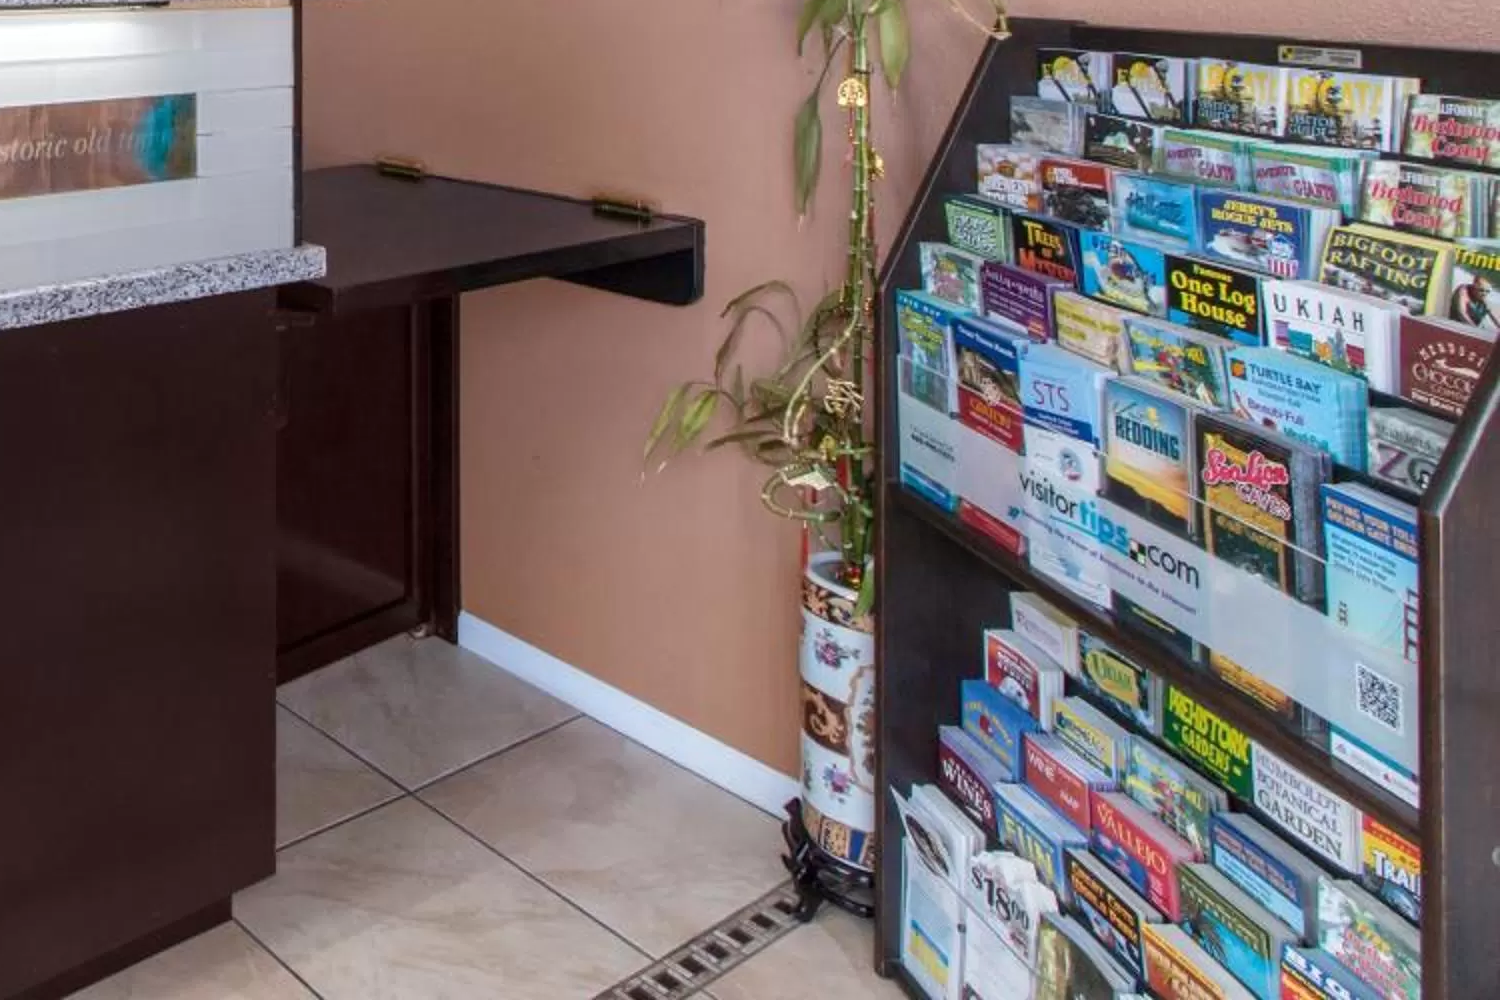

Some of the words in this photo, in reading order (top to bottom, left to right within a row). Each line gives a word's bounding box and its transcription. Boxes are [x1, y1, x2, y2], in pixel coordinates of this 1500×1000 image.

[73, 127, 112, 155] old
[1328, 250, 1429, 290] RAFTING
[1332, 234, 1434, 272] BIGFOOT
[1171, 269, 1214, 297] One
[1219, 281, 1256, 315] Log
[1180, 290, 1247, 329] House
[1273, 292, 1365, 333] UKIAH
[1033, 380, 1070, 412] STS
[1249, 362, 1294, 388] TURTLE
[1295, 377, 1322, 395] BAY
[1115, 414, 1180, 462] REDDING
[1181, 723, 1230, 773] GARDENS
[1256, 748, 1341, 815] HUMBOLDT
[1256, 768, 1342, 837] BOTANICAL
[1097, 801, 1167, 877] VALLEJO
[1257, 789, 1342, 861] GARDEN
